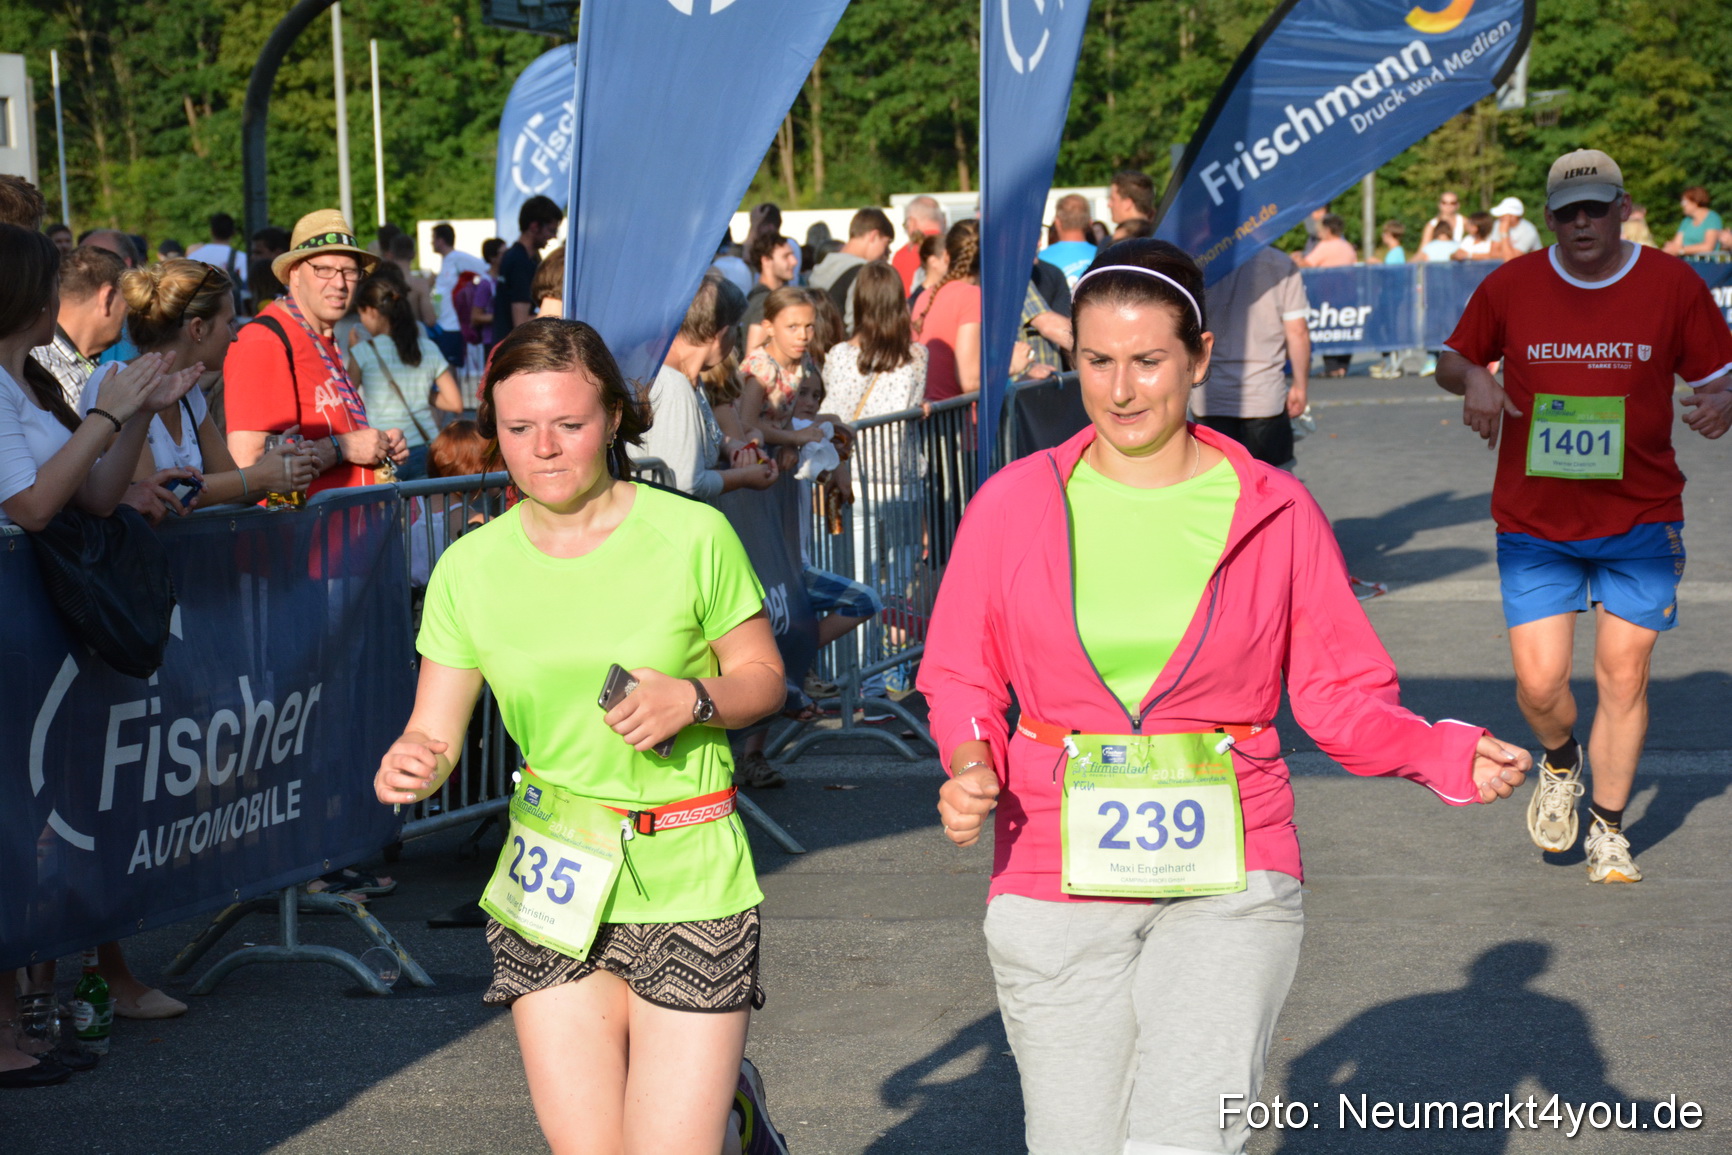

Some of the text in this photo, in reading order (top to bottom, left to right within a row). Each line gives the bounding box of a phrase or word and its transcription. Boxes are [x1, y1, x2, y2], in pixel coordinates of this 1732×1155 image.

[1350, 18, 1512, 134] Druck und Medien
[1199, 39, 1432, 206] Frischmann
[1564, 166, 1598, 180] LENZA
[1527, 342, 1633, 359] NEUMARKT
[1539, 428, 1611, 456] 1401
[98, 675, 322, 811] Fischer
[127, 779, 302, 874] AUTOMOBILE
[1097, 799, 1205, 851] 239
[508, 835, 582, 905] 235
[1110, 862, 1196, 876] Maxi Engelhardt
